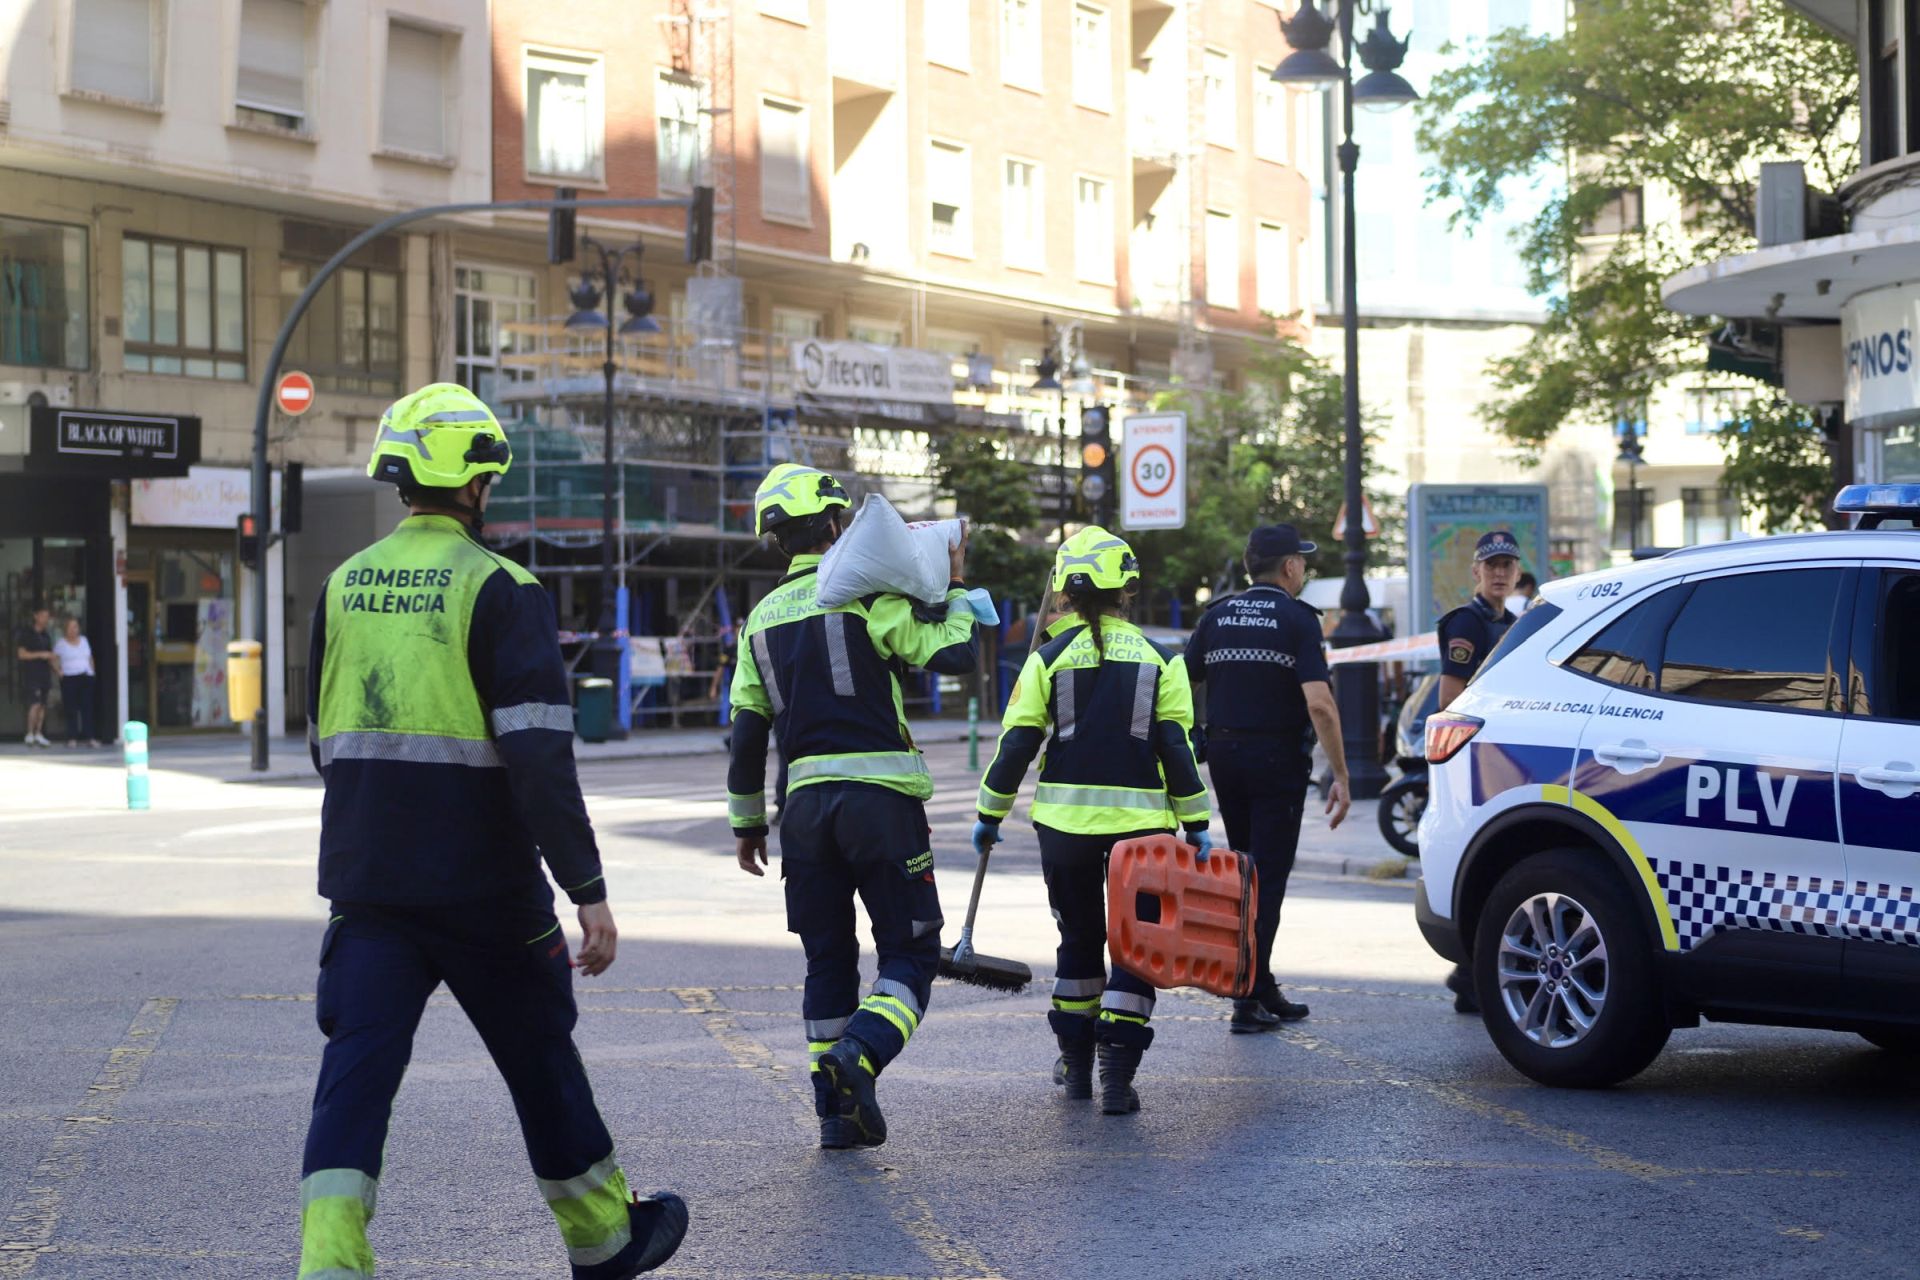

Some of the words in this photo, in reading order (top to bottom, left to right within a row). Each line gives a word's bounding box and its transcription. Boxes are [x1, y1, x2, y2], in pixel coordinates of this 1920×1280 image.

[1844, 328, 1913, 380] FONOS
[67, 423, 108, 443] BLACK
[108, 425, 127, 444] OF
[126, 426, 166, 447] WHITE
[1141, 463, 1166, 480] 30
[344, 568, 453, 588] BOMBERS
[763, 587, 817, 608] BOMBE
[1591, 581, 1623, 598] 092
[342, 590, 445, 614] VALÈNCIA
[1227, 599, 1276, 609] POLICIA
[1236, 608, 1262, 616] LOCAL
[760, 603, 817, 624] VALÈNC
[1217, 616, 1278, 629] VALÈNCIA
[1070, 633, 1144, 651] BOBERS
[1070, 647, 1143, 667] VALNCIA
[1501, 700, 1551, 711] POLICIA
[1553, 702, 1594, 714] LOCAL
[1598, 705, 1665, 721] VALENCIA
[1685, 764, 1799, 828] PLV
